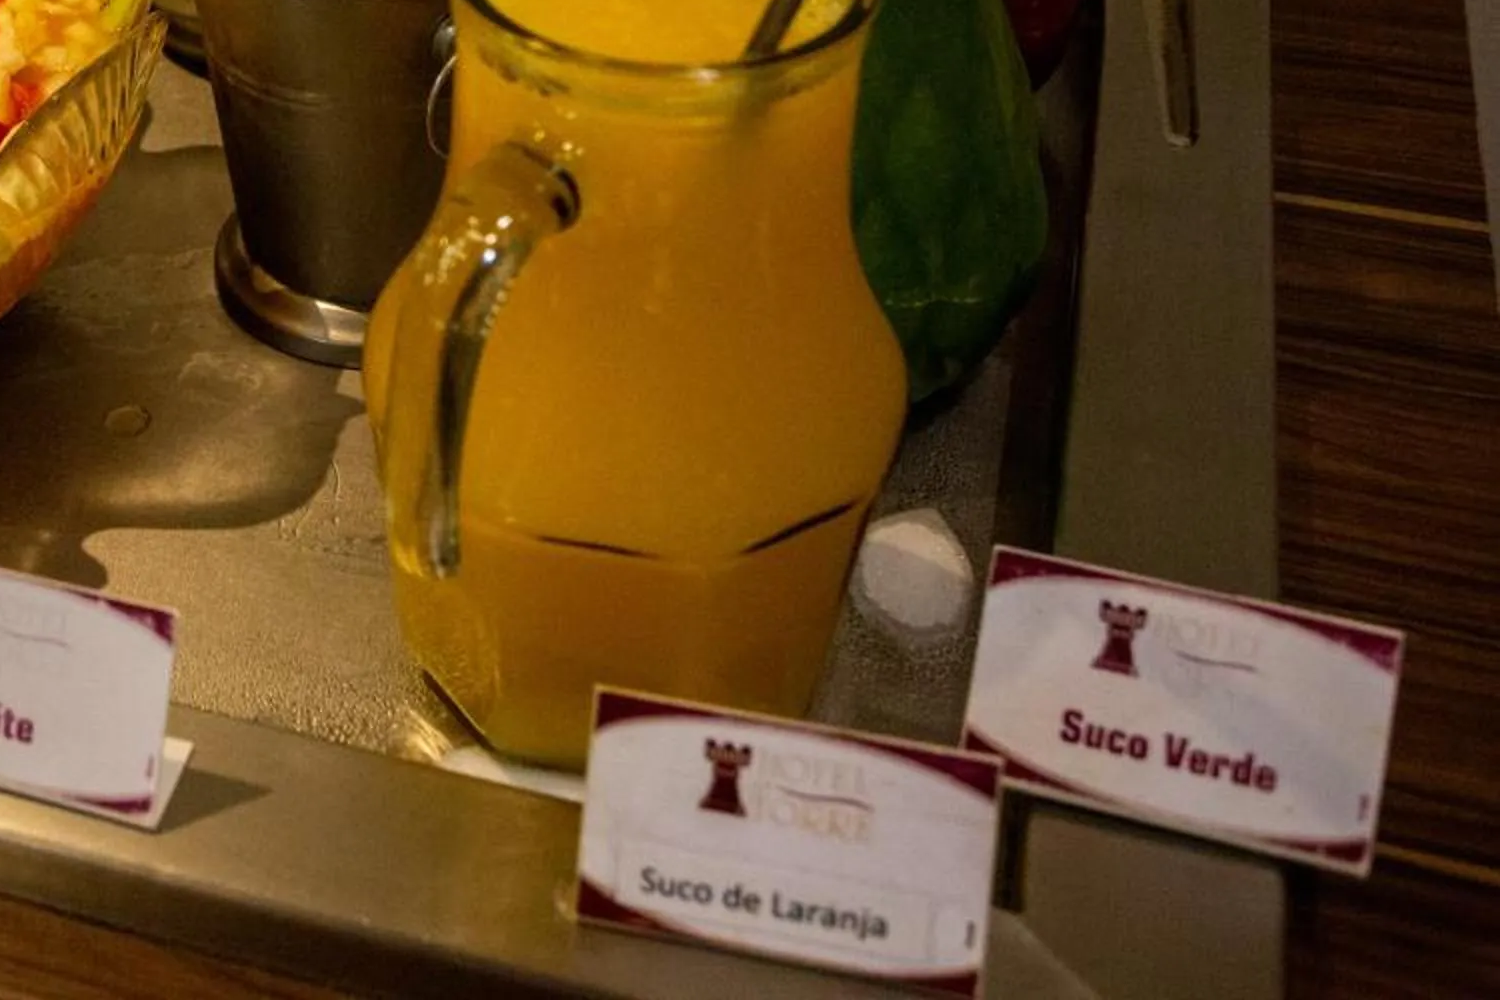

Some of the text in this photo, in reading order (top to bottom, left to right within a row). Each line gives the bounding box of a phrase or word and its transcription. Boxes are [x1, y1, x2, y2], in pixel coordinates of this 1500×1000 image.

[1060, 708, 1278, 792] Suco Verde
[640, 865, 890, 941] Suco de Laranja
